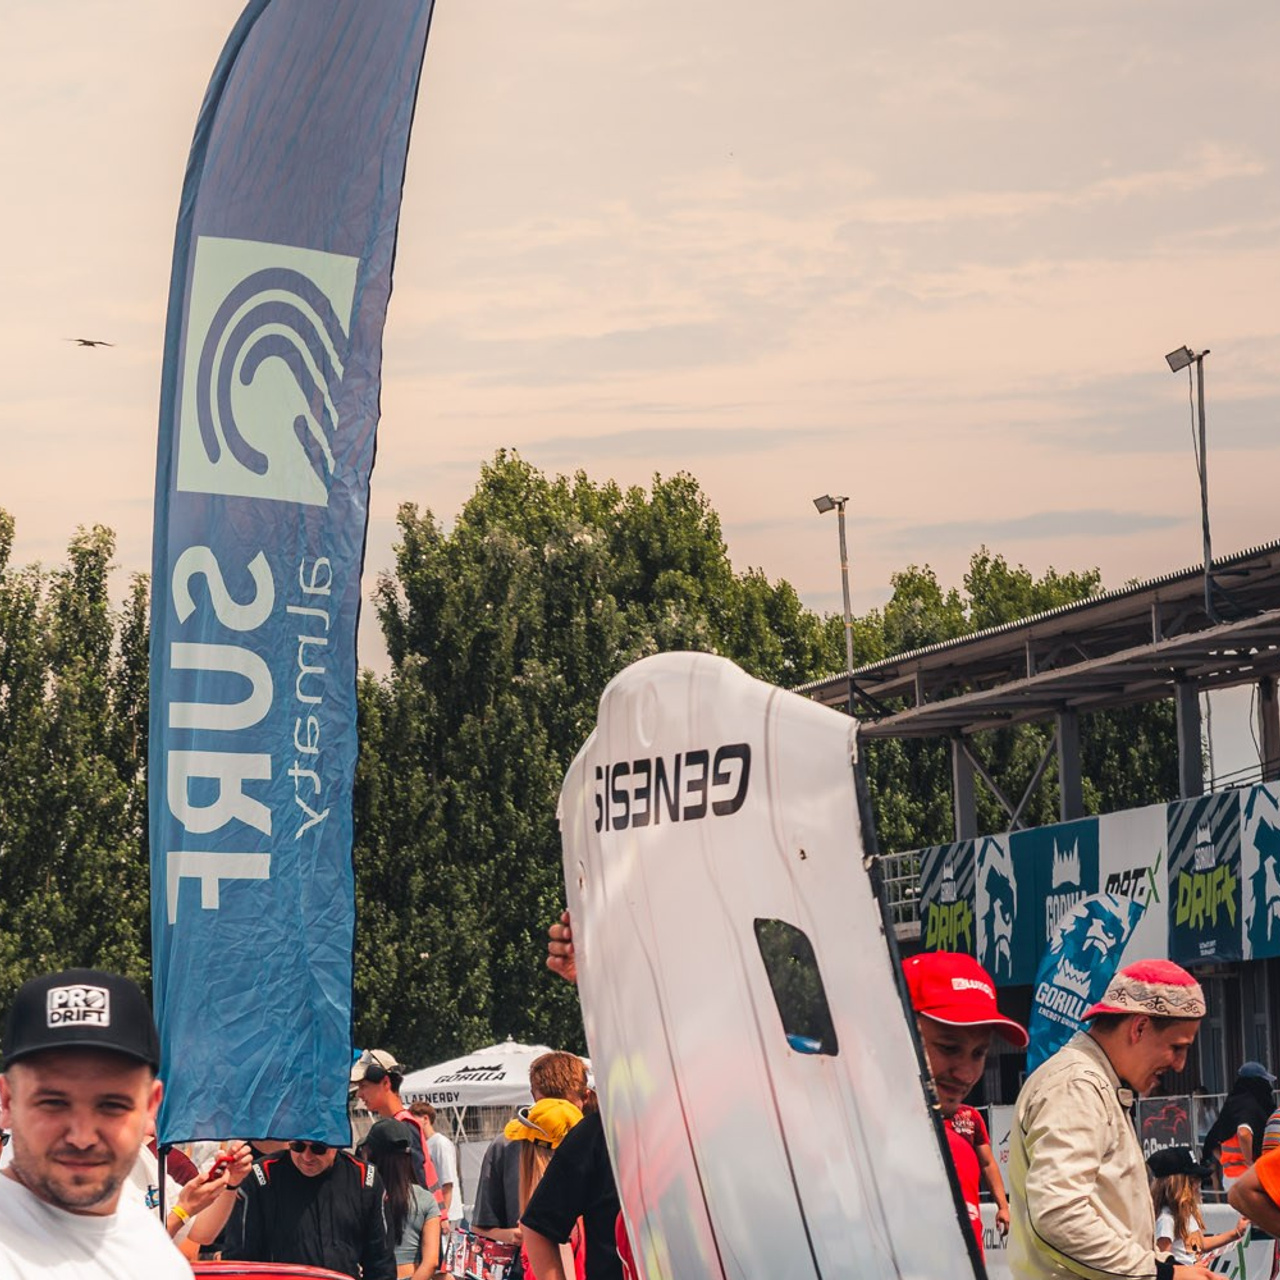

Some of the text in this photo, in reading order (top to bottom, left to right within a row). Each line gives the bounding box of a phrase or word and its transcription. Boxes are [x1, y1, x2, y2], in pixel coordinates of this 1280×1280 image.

[50, 988, 105, 1009] PRO
[50, 1009, 105, 1024] DRIFT
[433, 1071, 508, 1085] GORILLA
